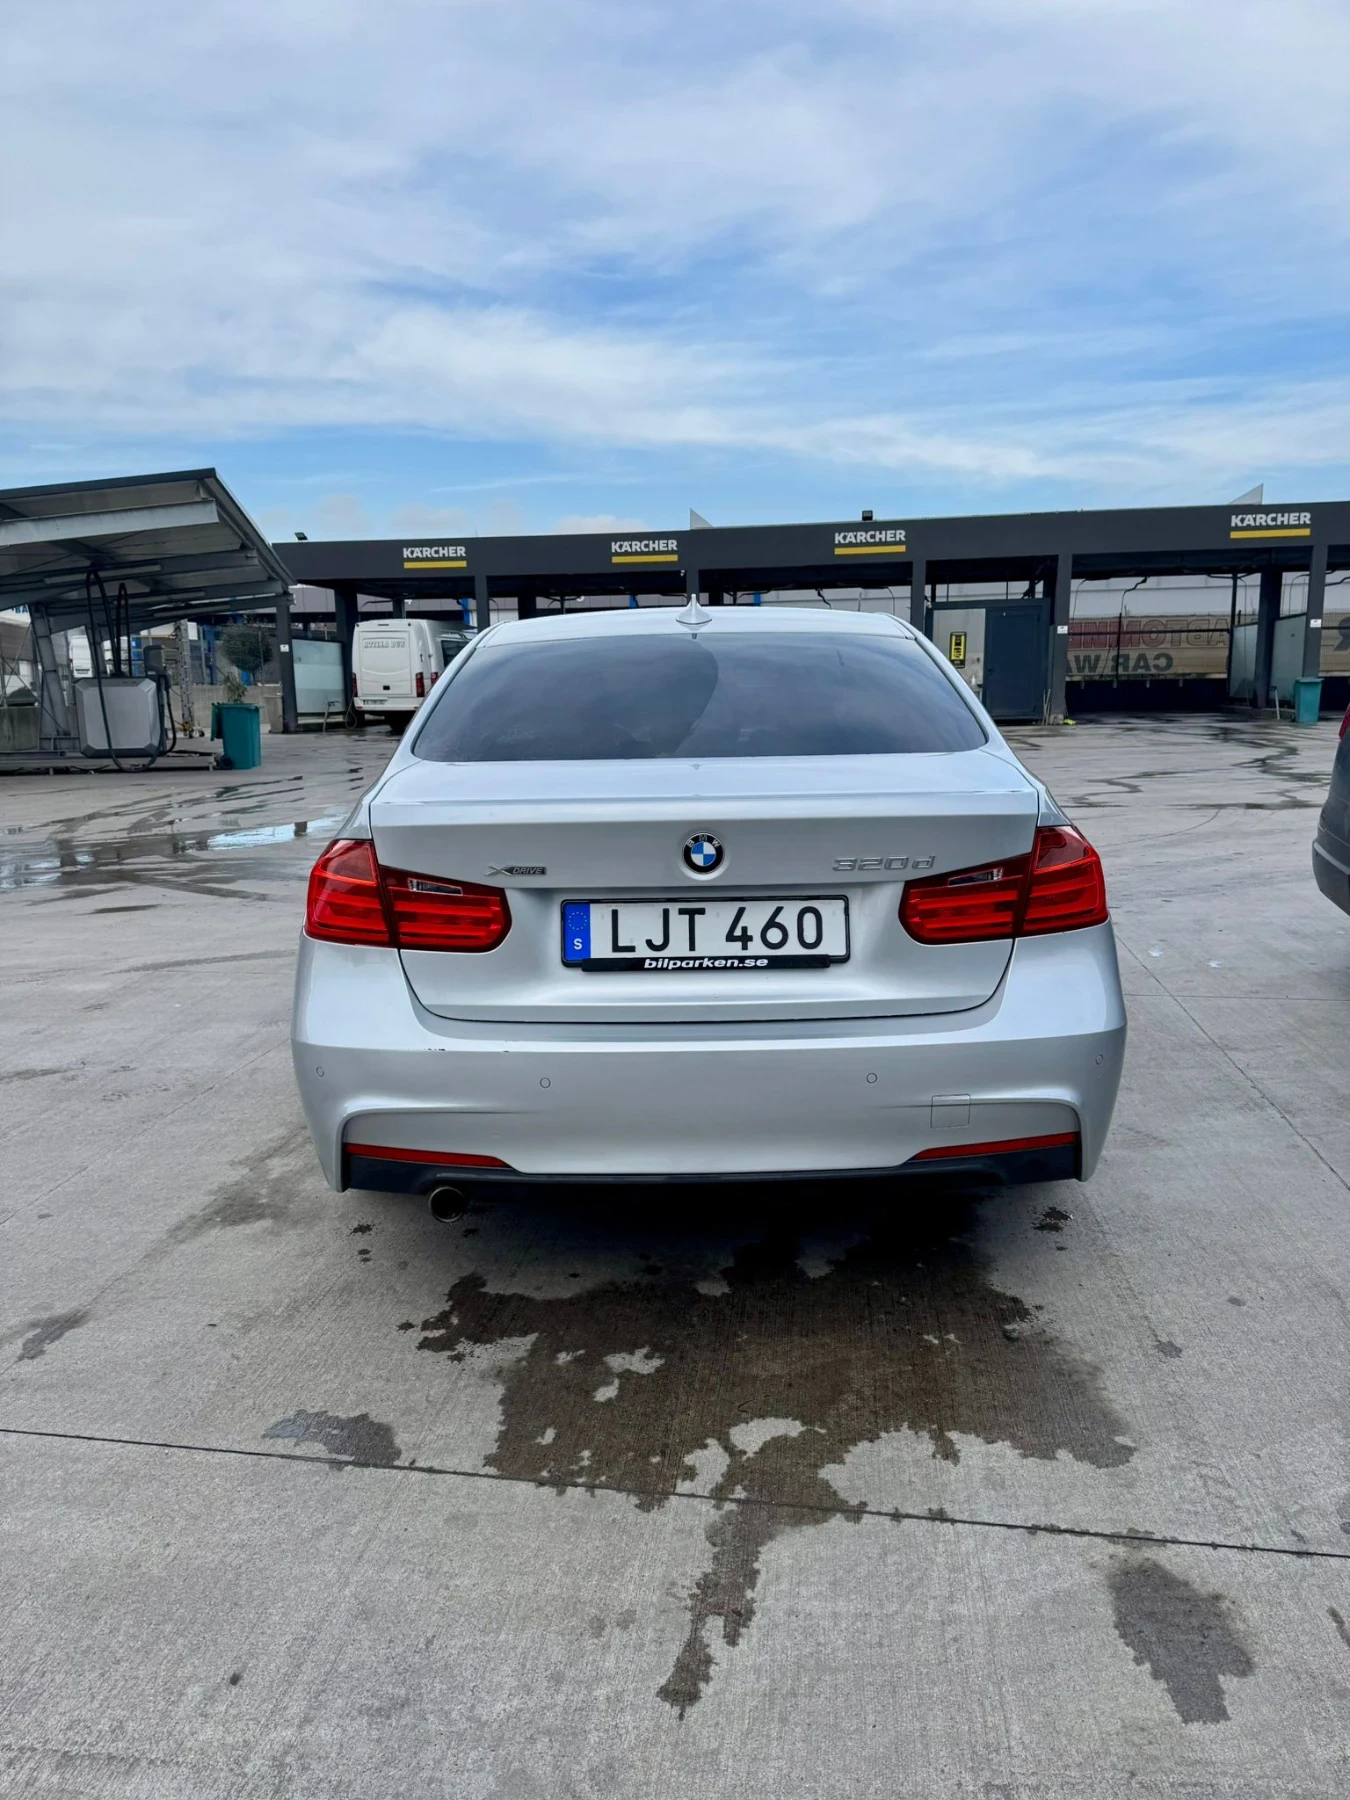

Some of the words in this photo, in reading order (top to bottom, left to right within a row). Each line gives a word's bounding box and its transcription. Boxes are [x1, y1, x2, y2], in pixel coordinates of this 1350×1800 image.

[1230, 511, 1312, 527] KÄRCHER
[834, 529, 907, 544] KÄRCHER
[402, 546, 467, 559] KÄRCHER
[611, 539, 678, 553] KÄRCHER
[684, 833, 721, 848] BMW
[611, 906, 706, 953] LJT
[725, 905, 824, 951] 460
[573, 938, 583, 950] S
[643, 957, 769, 970] bilparken.se
